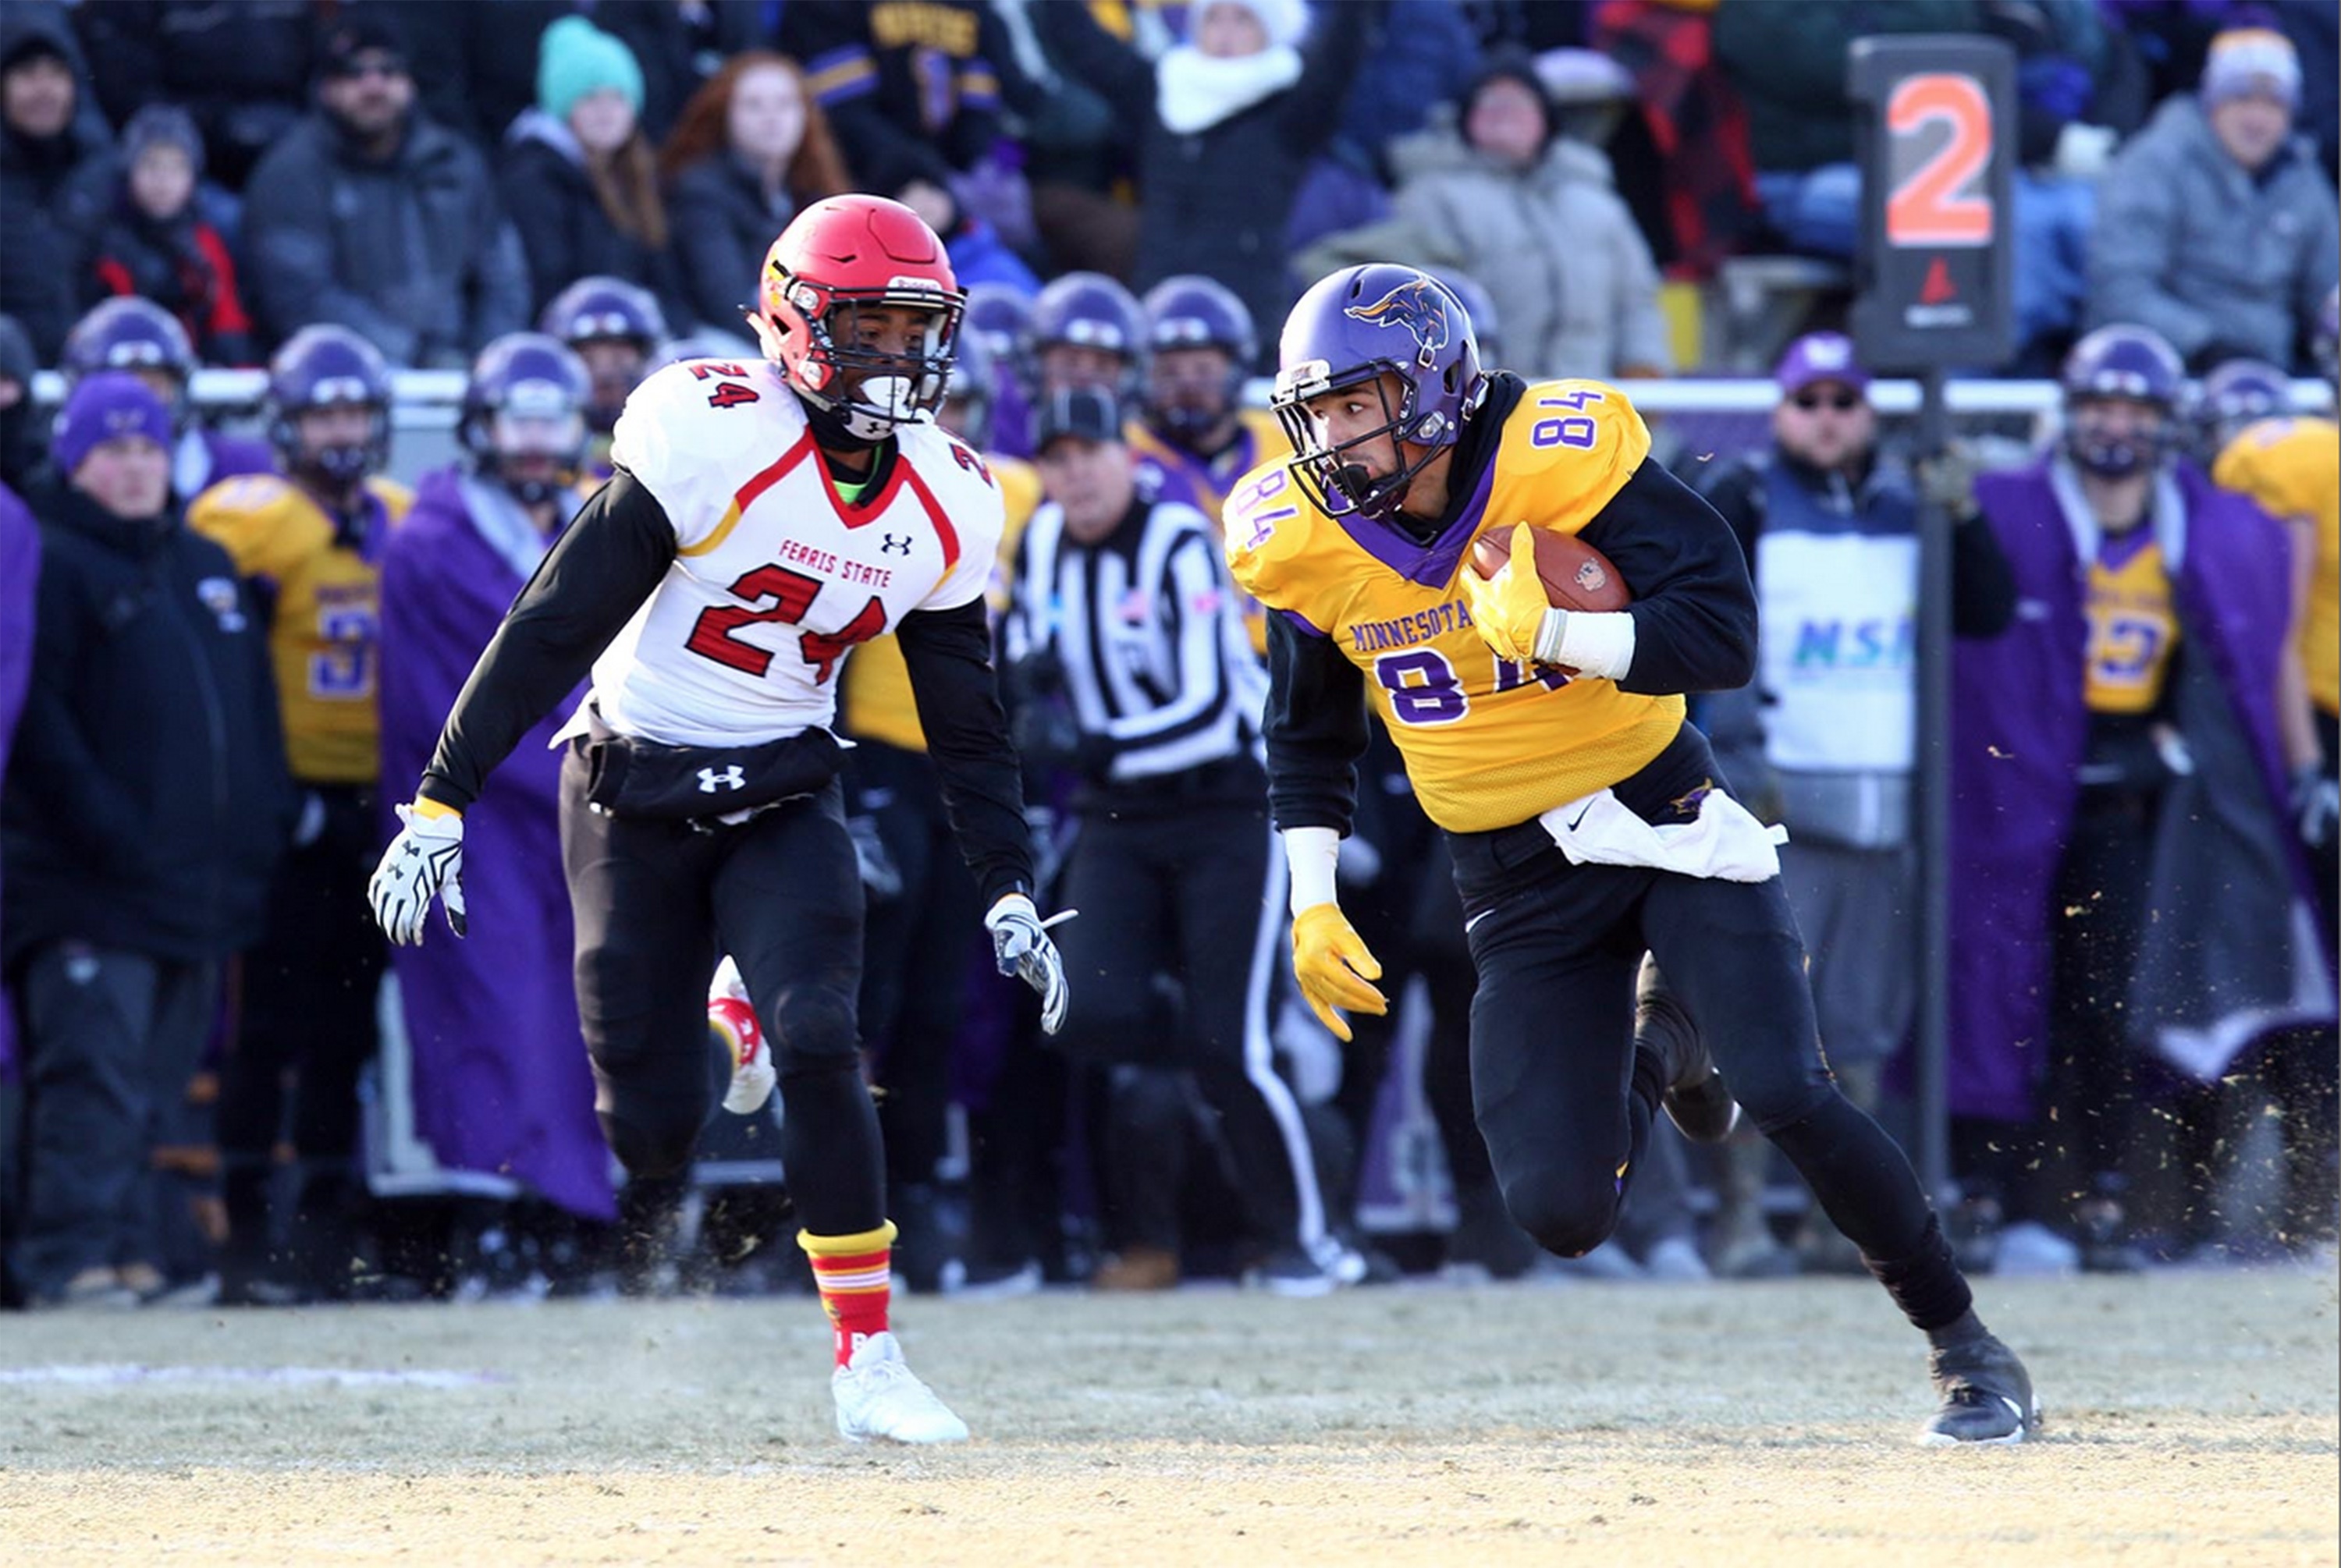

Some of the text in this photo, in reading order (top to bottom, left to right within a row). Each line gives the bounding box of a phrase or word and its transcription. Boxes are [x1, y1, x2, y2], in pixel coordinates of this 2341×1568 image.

[1887, 73, 1994, 247] 2
[687, 363, 761, 409] 24
[1531, 390, 1604, 451] 84
[1234, 467, 1298, 551] 84
[778, 539, 892, 588] FERRIS STATE
[684, 562, 887, 686] 24
[1349, 598, 1475, 651] MINNESOTA
